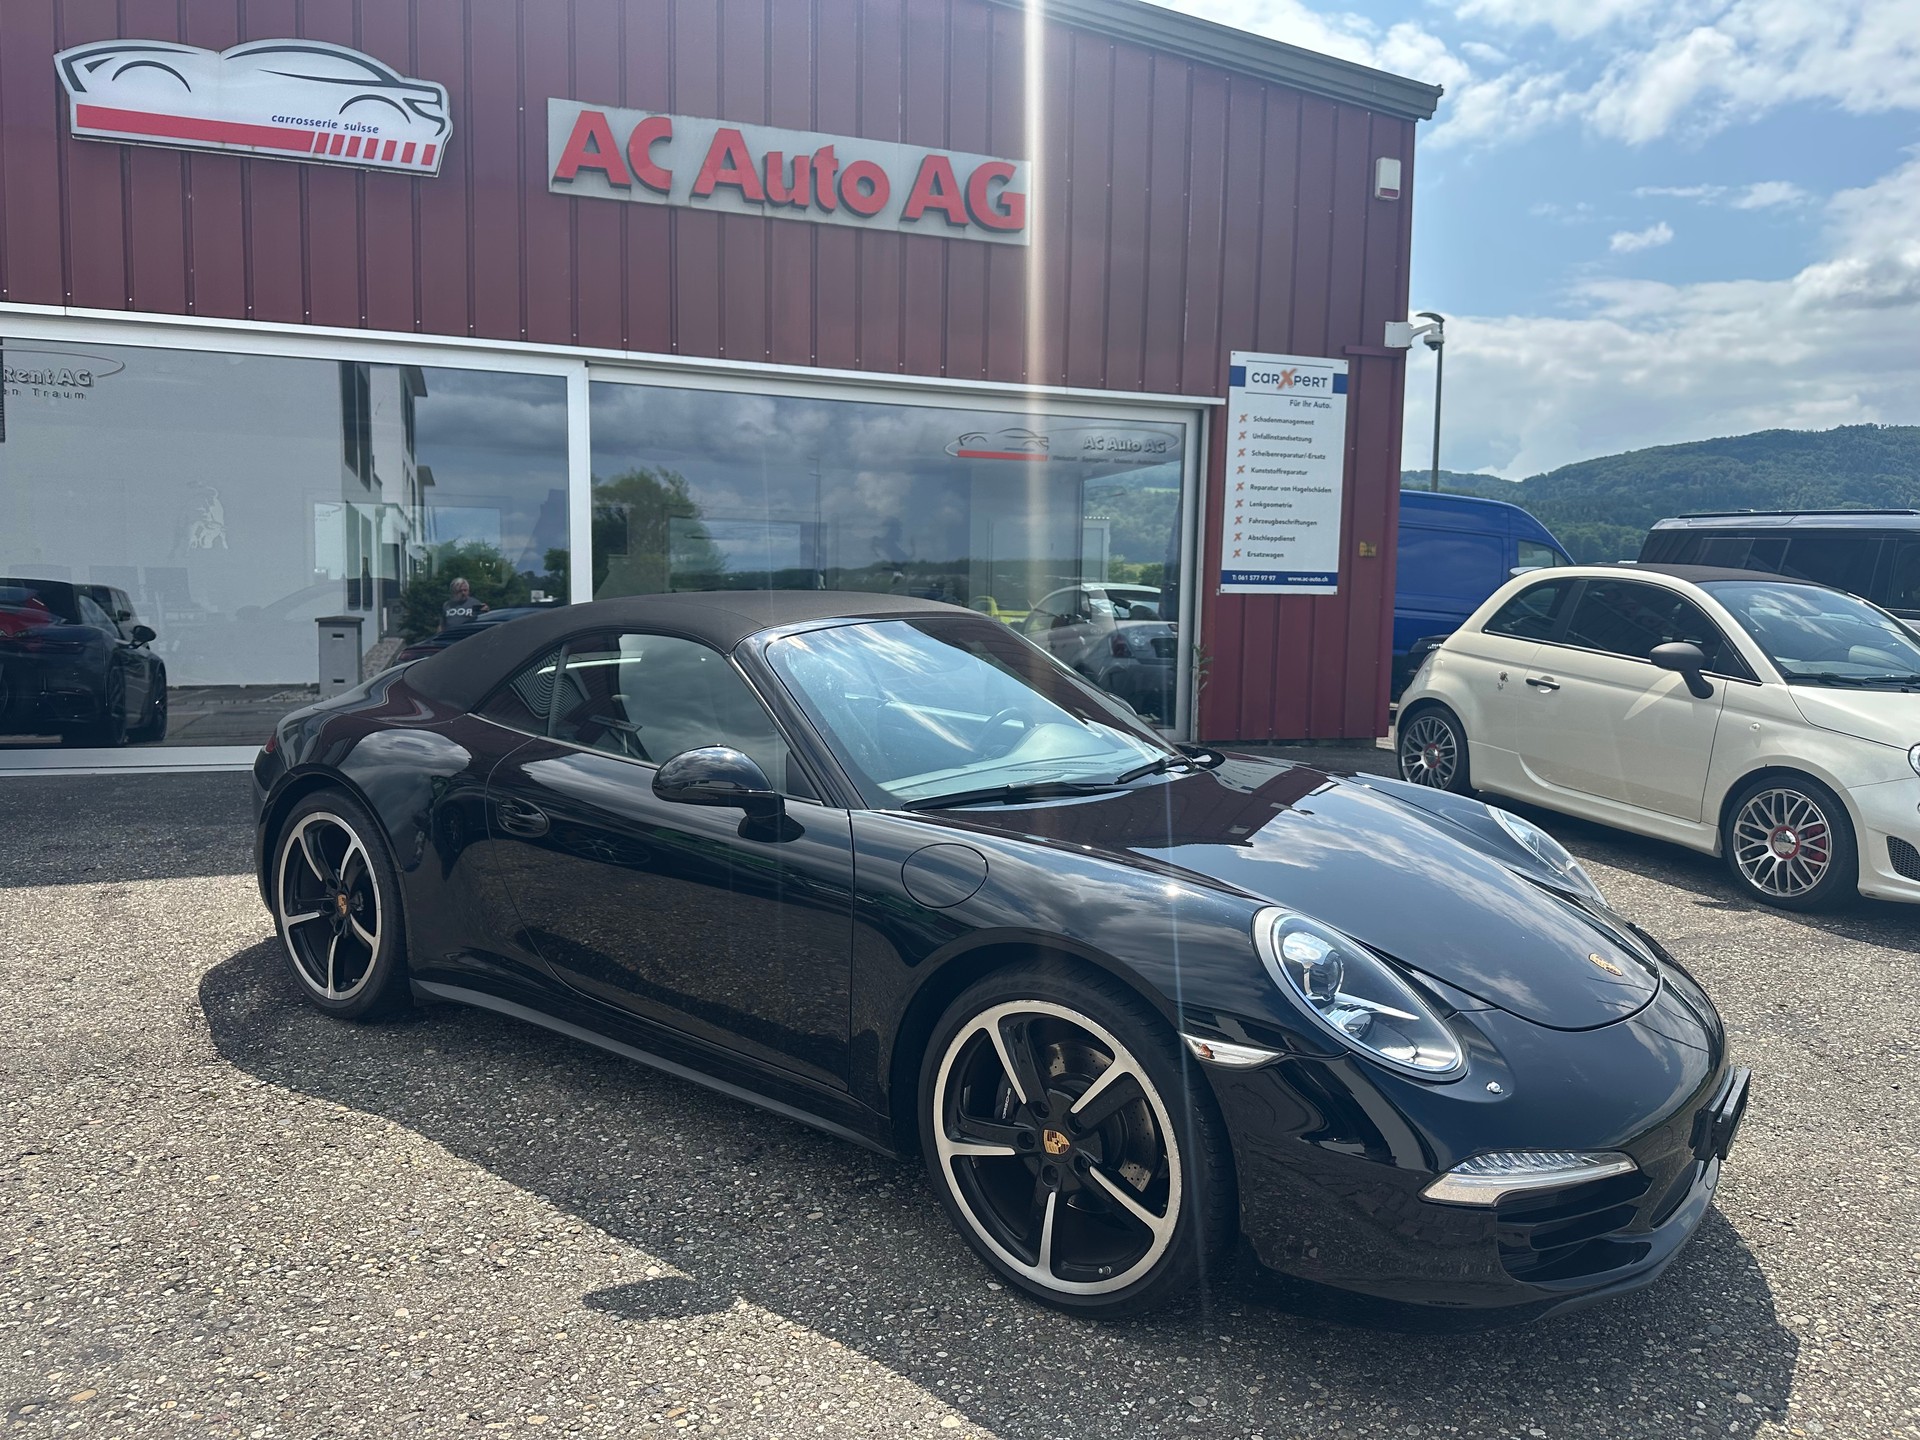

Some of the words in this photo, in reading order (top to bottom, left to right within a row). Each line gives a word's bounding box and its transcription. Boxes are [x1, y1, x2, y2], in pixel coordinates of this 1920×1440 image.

[271, 114, 338, 129] carrosserie
[344, 122, 379, 134] suisse
[551, 110, 673, 196] AC
[690, 127, 891, 217] Auto
[900, 154, 1026, 232] AG
[4, 365, 55, 385] Rent
[57, 367, 94, 387] AG
[32, 387, 85, 400] Traum
[1289, 399, 1301, 407] Für
[1302, 400, 1311, 408] Ihr
[1253, 416, 1315, 426] Schadenmanagement
[1252, 433, 1312, 443] Unfallinstandsetzung
[1083, 435, 1104, 450] AC
[1107, 437, 1142, 452] Auto
[1144, 438, 1167, 454] AG
[1250, 467, 1308, 476] Kunststoffreparatur
[1250, 484, 1279, 492] Reparatur
[1292, 486, 1332, 494] Hagelschäden
[1249, 501, 1293, 509] Lenkgeometrie
[1248, 518, 1318, 527] Fahrzeugbeschriftungen
[1247, 551, 1285, 559] Ersatzwagen
